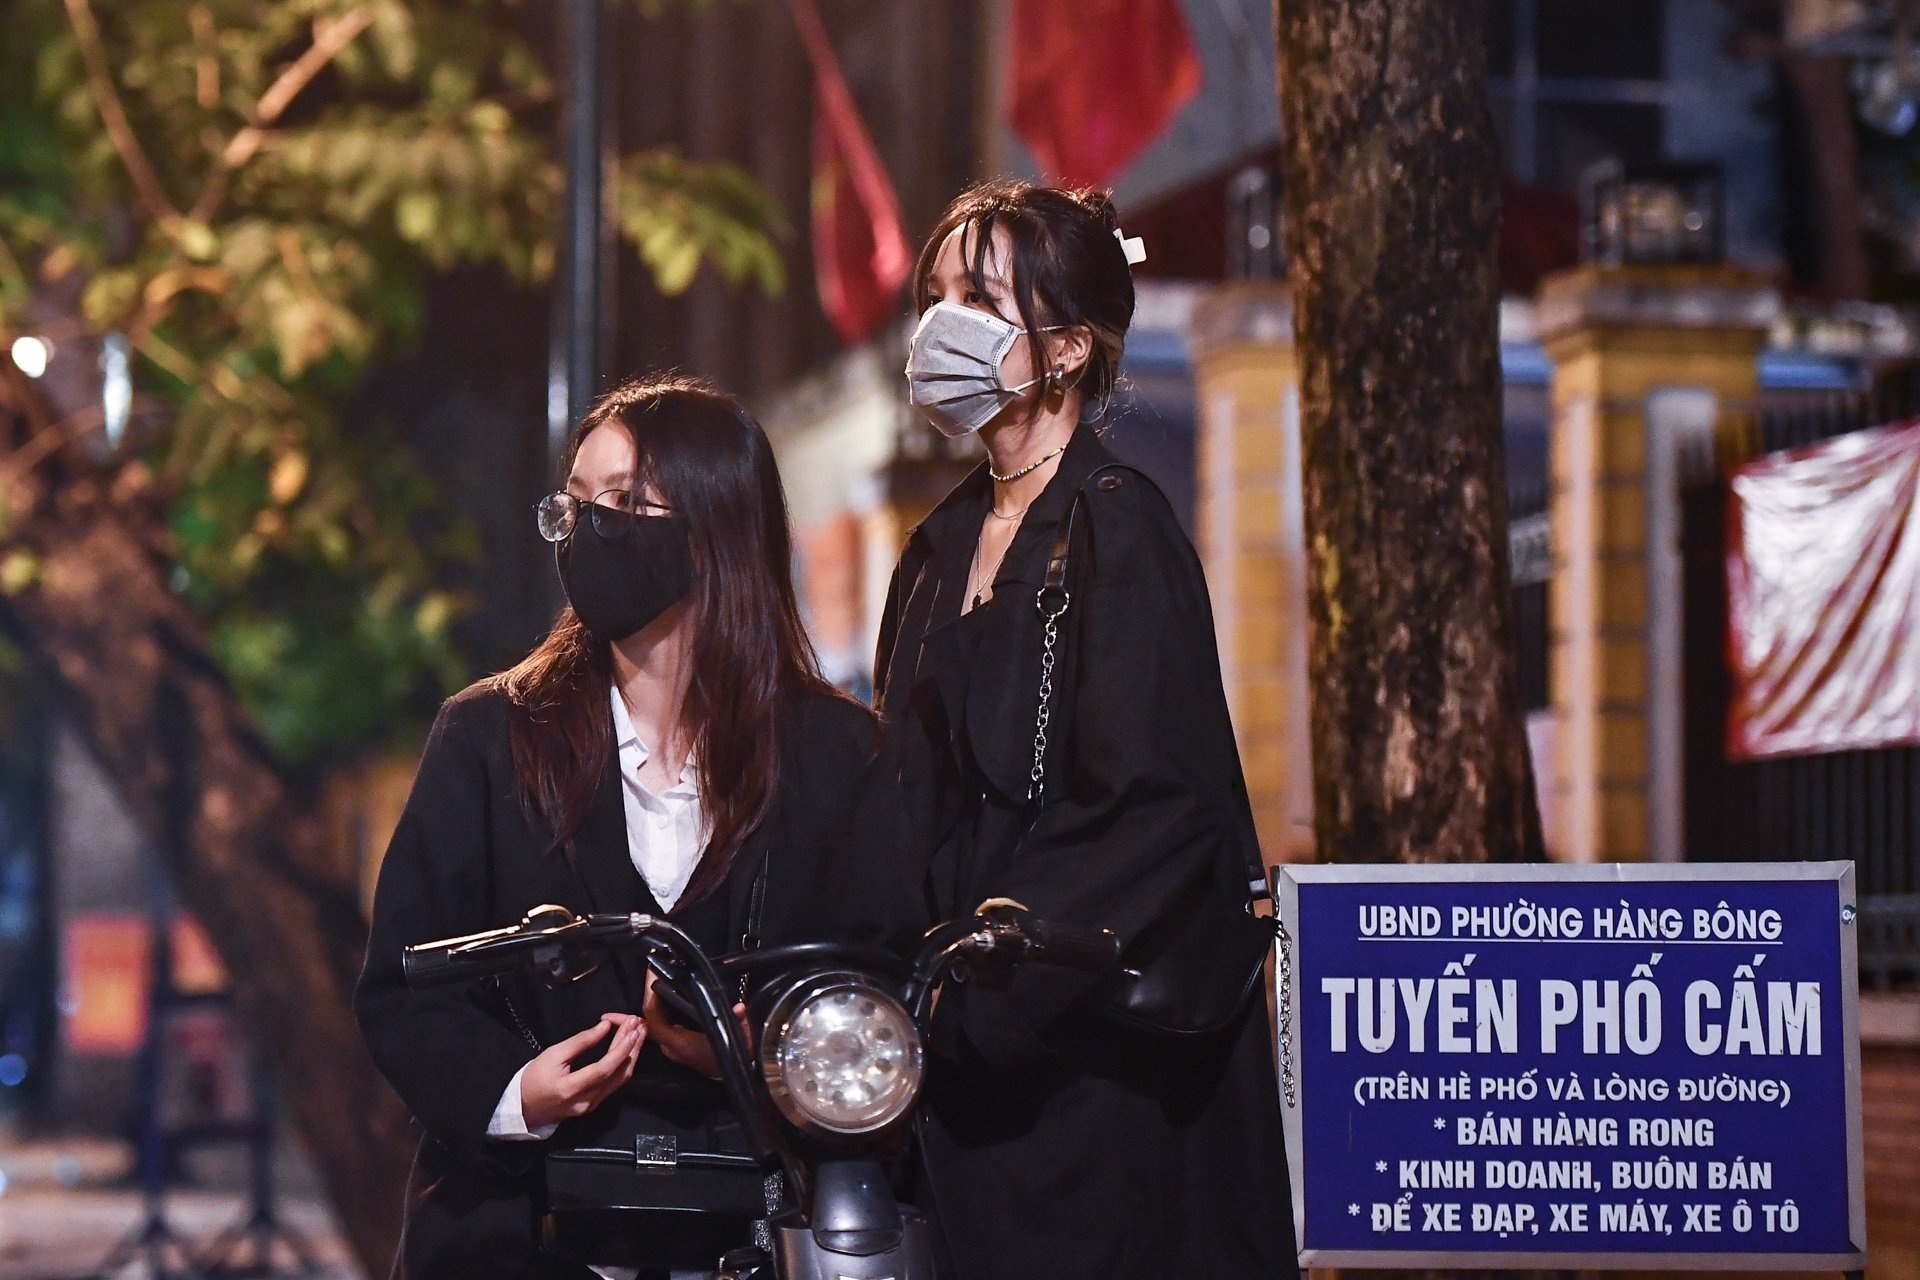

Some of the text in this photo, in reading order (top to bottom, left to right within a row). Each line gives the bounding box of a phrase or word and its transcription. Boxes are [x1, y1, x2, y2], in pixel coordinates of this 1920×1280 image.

[1358, 898, 1783, 940] UBND PHƯỜNG HÀNG BÔNG
[1322, 953, 1822, 1056] TUYẾN PHỐ CẤM
[1354, 1068, 1791, 1108] (TRÊN HÈ PHỐ VÀ LÒNG ĐƯỜNG)
[1457, 1111, 1714, 1147] BÁN HÀNG RONG
[1400, 1156, 1772, 1193] KINH DOANH, BUÔN BÁN
[1371, 1192, 1800, 1238] ĐỂ XE ĐẠP, XE MÁY, XE Ô TÔ
